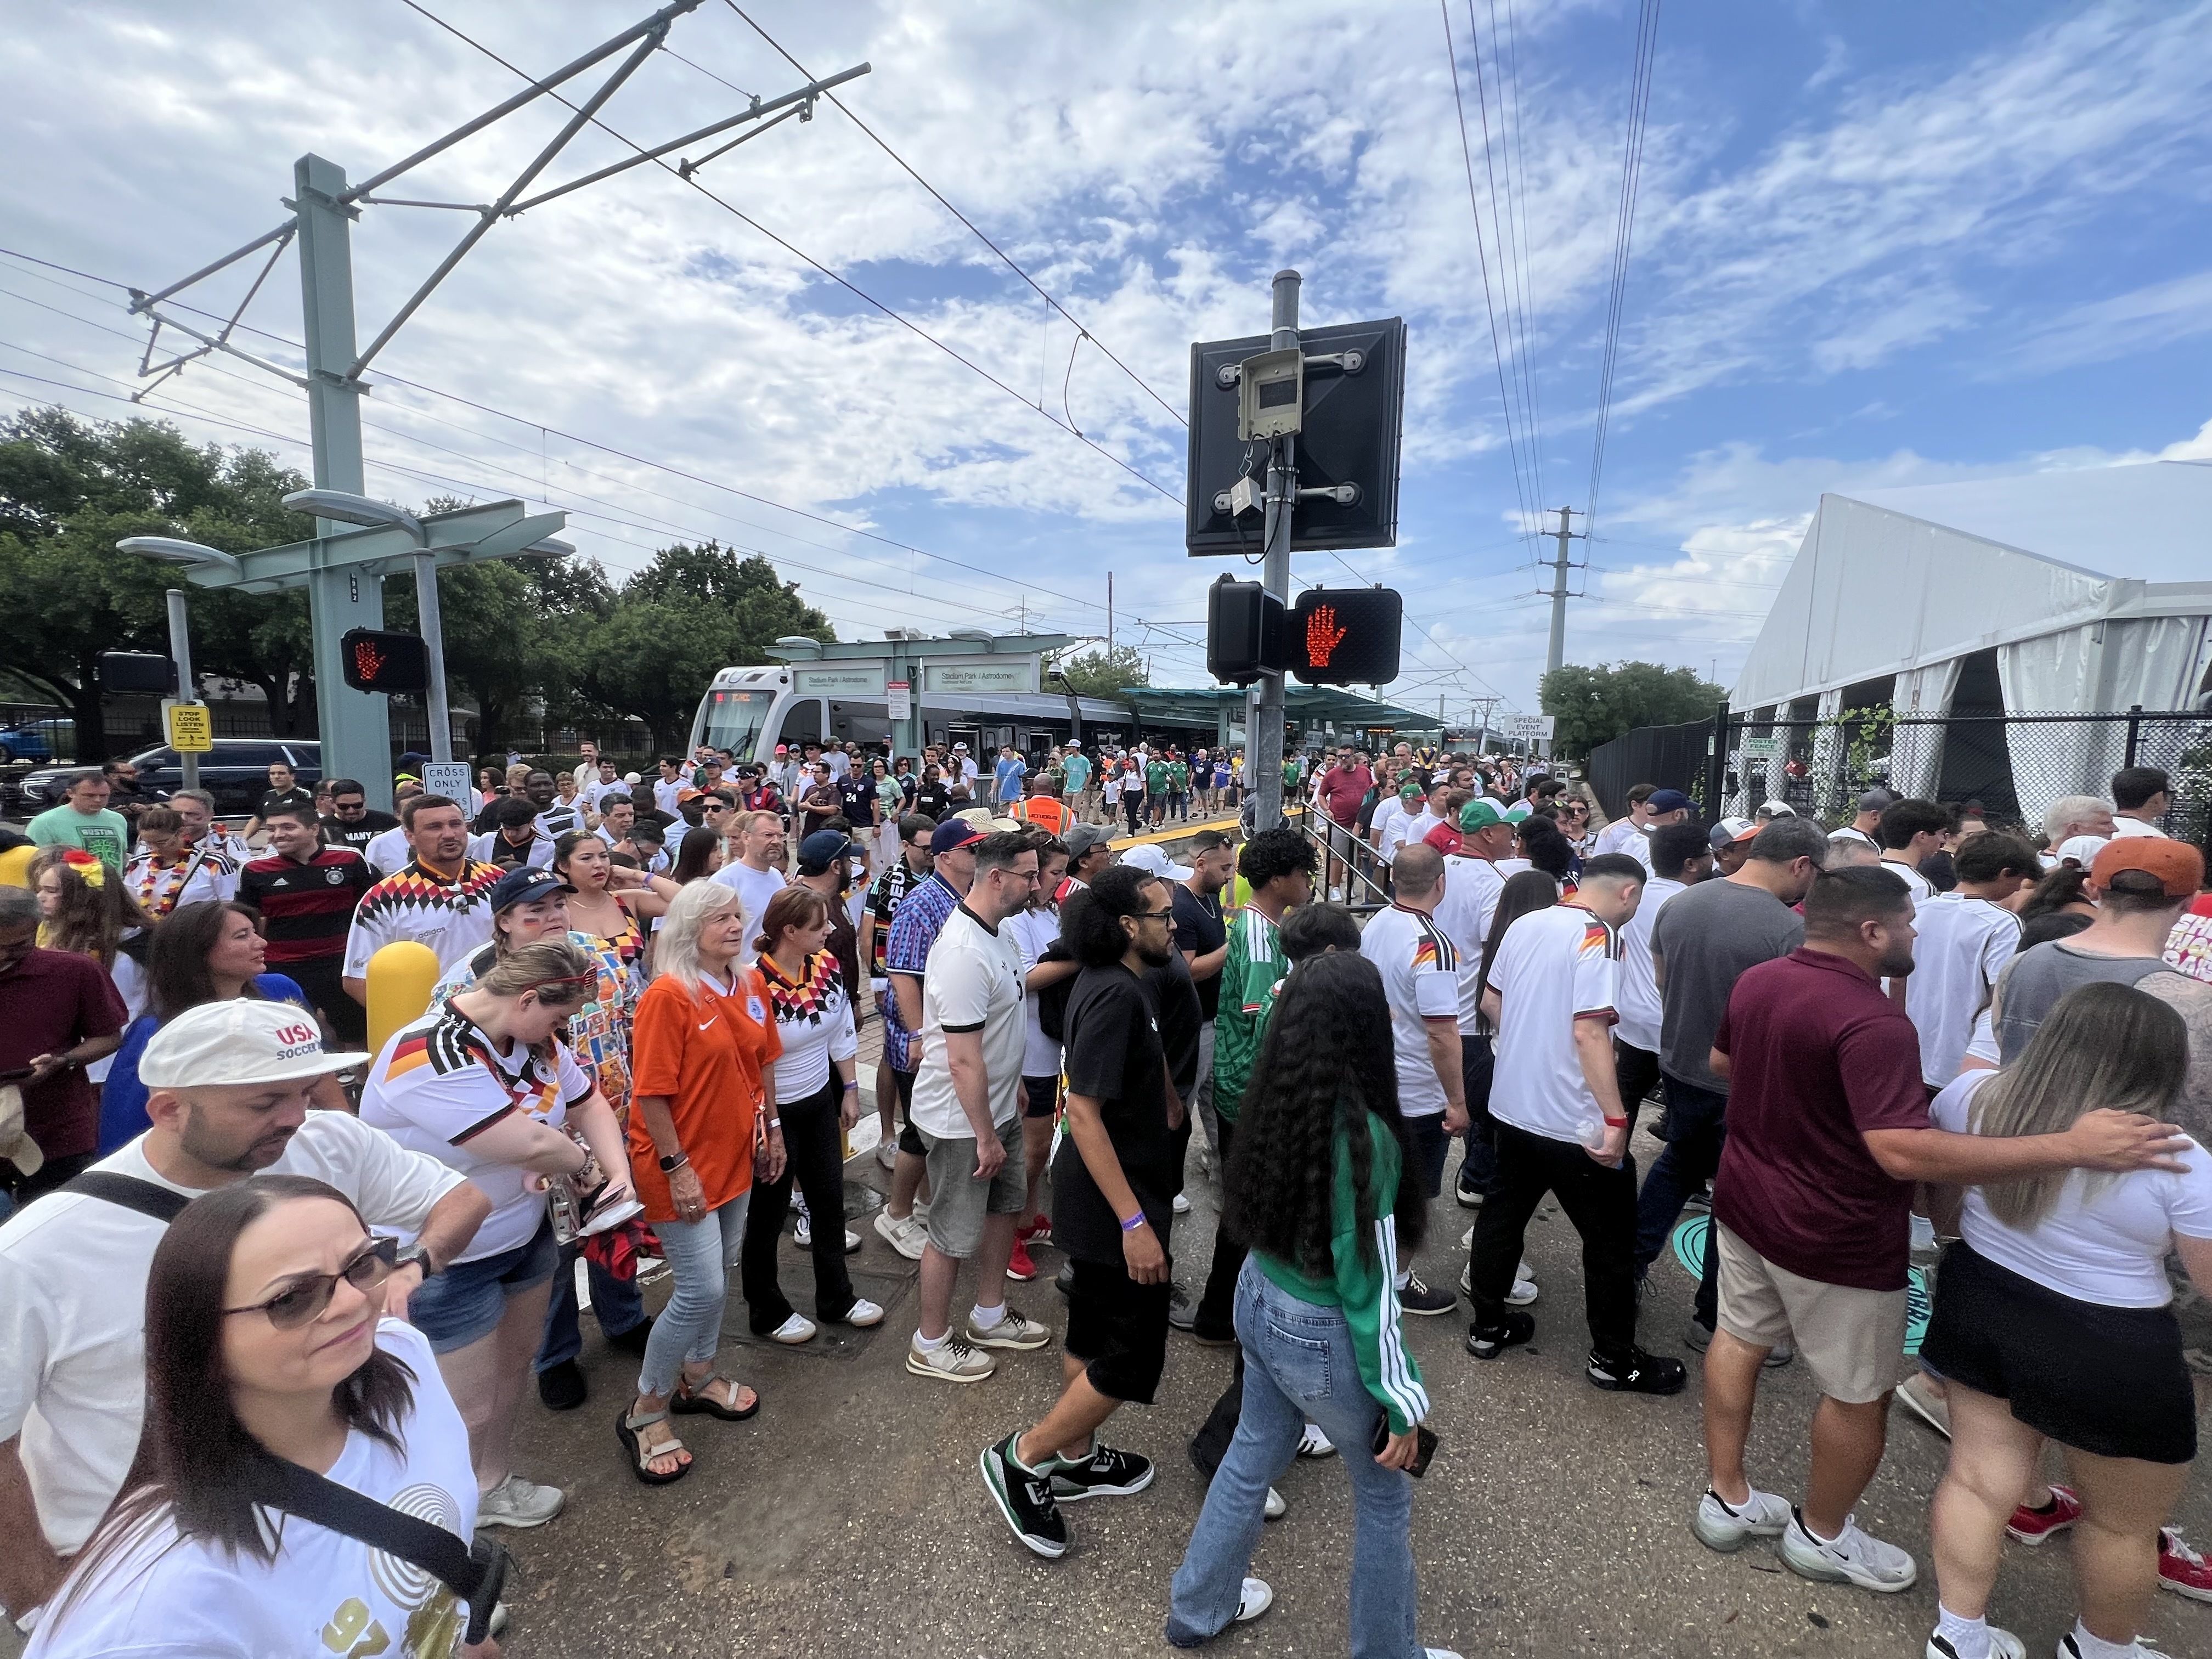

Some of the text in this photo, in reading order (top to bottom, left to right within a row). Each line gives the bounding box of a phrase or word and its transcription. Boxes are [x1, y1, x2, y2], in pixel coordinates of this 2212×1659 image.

[430, 768, 465, 777] CROSS
[435, 780, 461, 788] ONLY
[845, 792, 857, 803] 24
[275, 1022, 318, 1045] USA
